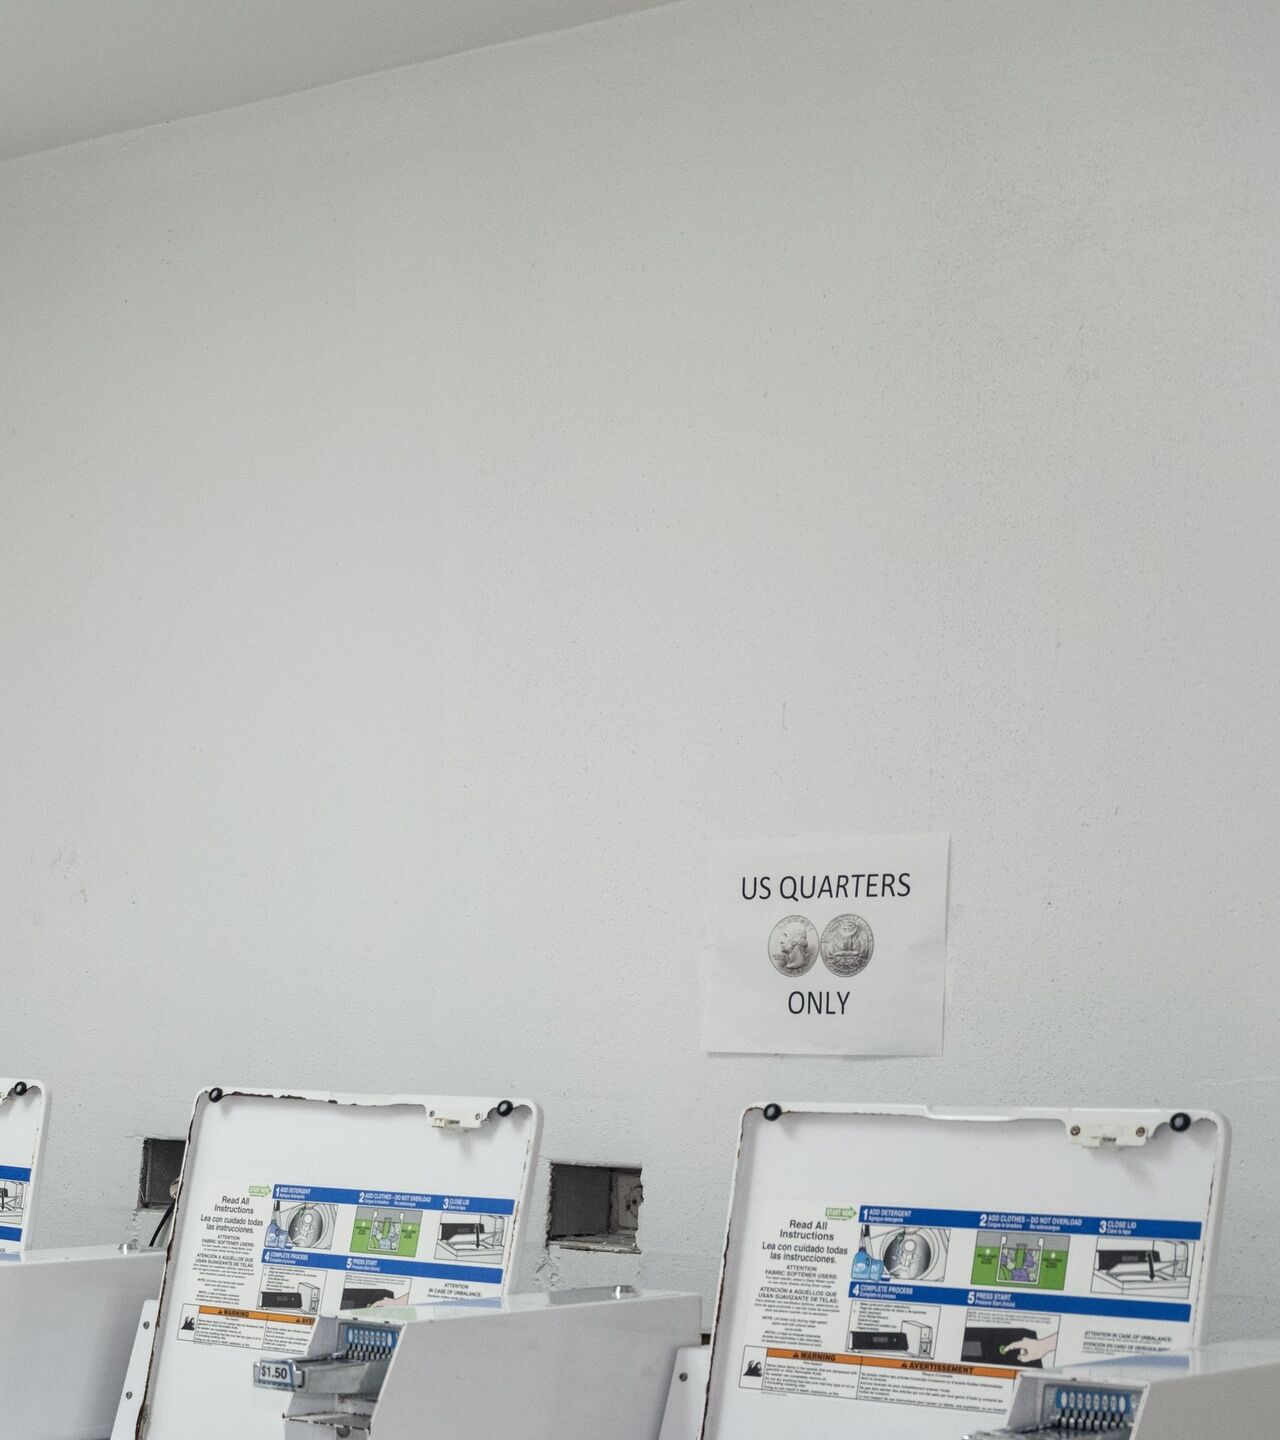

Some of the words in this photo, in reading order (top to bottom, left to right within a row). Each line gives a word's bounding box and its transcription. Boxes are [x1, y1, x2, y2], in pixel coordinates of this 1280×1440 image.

[742, 876, 771, 900] US
[779, 872, 911, 902] QUARTERS
[788, 991, 850, 1015] ONLY
[275, 1188, 280, 1198] 1
[359, 1191, 365, 1203] 2
[222, 1195, 240, 1204] Read
[443, 1197, 449, 1209] 3
[214, 1204, 254, 1214] Instructions
[863, 1209, 868, 1220] 1
[881, 1209, 912, 1217] DETERGENT
[201, 1214, 211, 1222] Lea
[980, 1213, 987, 1226] 2
[1000, 1215, 1025, 1223] CLOTHES
[1051, 1218, 1083, 1226] OVERLOAD
[789, 1219, 813, 1229] Read
[815, 1221, 828, 1230] All
[1099, 1220, 1107, 1233] 3
[1108, 1220, 1126, 1228] CLOSE
[779, 1229, 835, 1241] Instructions
[762, 1241, 776, 1250] Lea
[778, 1243, 792, 1251] con
[794, 1244, 825, 1253] cuidado
[827, 1246, 848, 1255] todas
[264, 1251, 270, 1262] 4
[770, 1251, 781, 1260] las
[783, 1253, 837, 1264] instrucciones.
[346, 1258, 352, 1269] 5
[853, 1284, 859, 1296] 4
[967, 1291, 975, 1304] 5
[800, 1351, 836, 1362] WARNING
[261, 1365, 288, 1380] $1.50
[909, 1361, 974, 1374] AVERTISSEMENT
